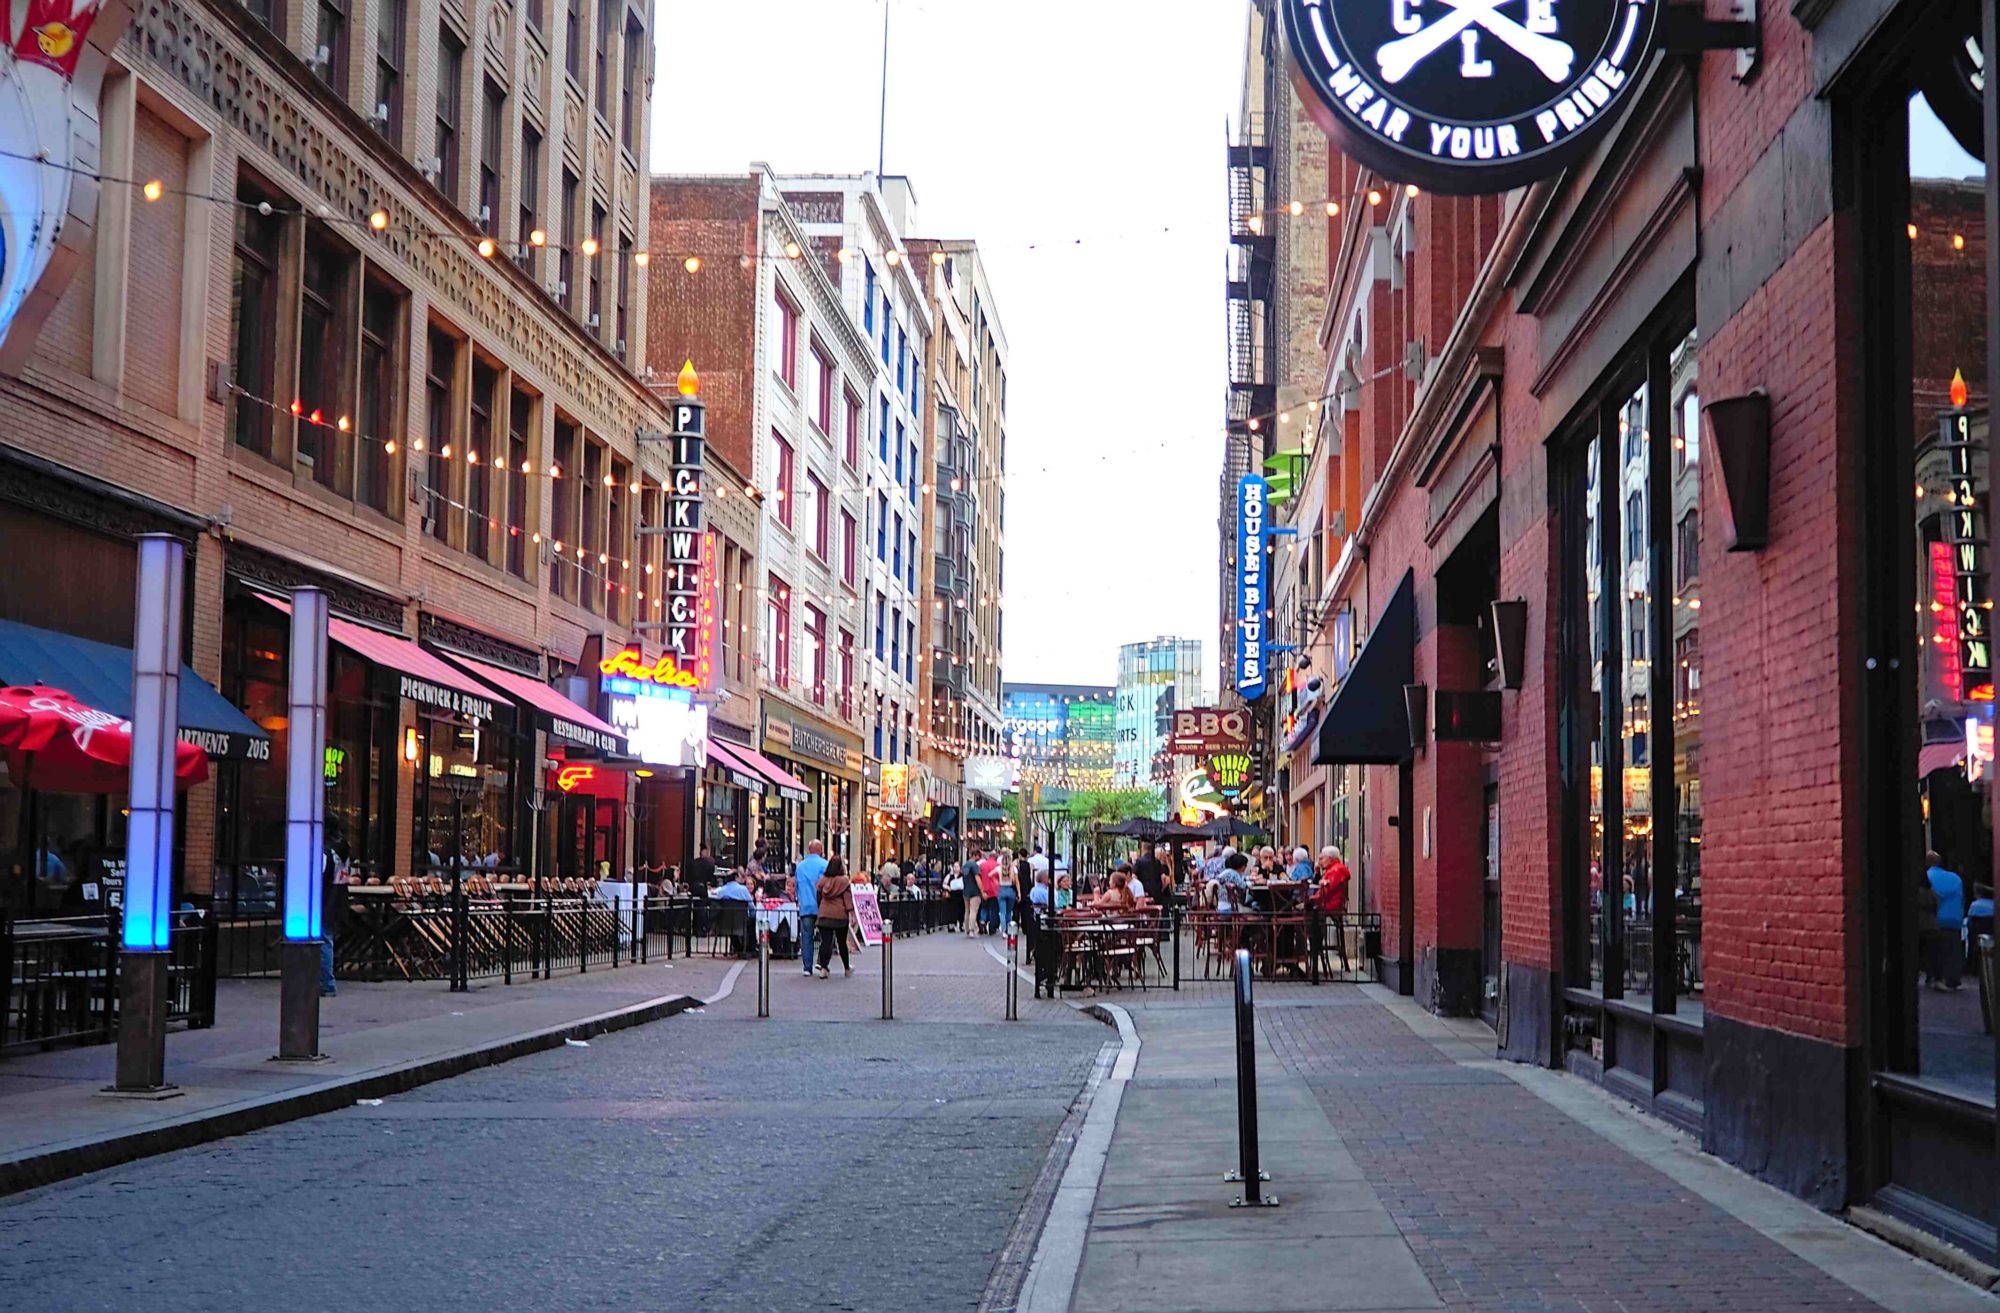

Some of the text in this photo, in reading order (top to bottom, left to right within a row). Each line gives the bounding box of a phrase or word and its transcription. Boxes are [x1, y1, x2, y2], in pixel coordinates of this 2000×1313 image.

[1461, 29, 1493, 78] L
[1329, 57, 1627, 159] WEAR YOUR PRIDE
[672, 406, 692, 654] PICKWICK
[1244, 484, 1261, 571] HOUSE
[701, 534, 713, 690] RESTAURANT
[1245, 588, 1260, 678] BLUES
[400, 676, 493, 721] PICKWICK & FROLIC
[177, 728, 270, 761] ARTMENTS 2015
[552, 718, 594, 747] RESTAURANT
[601, 732, 617, 753] CLUB
[1177, 712, 1248, 742] BBQ
[1212, 755, 1250, 773] WONDER
[1221, 770, 1240, 787] BAR
[102, 859, 115, 868] Yes
[102, 877, 122, 886] Tours
